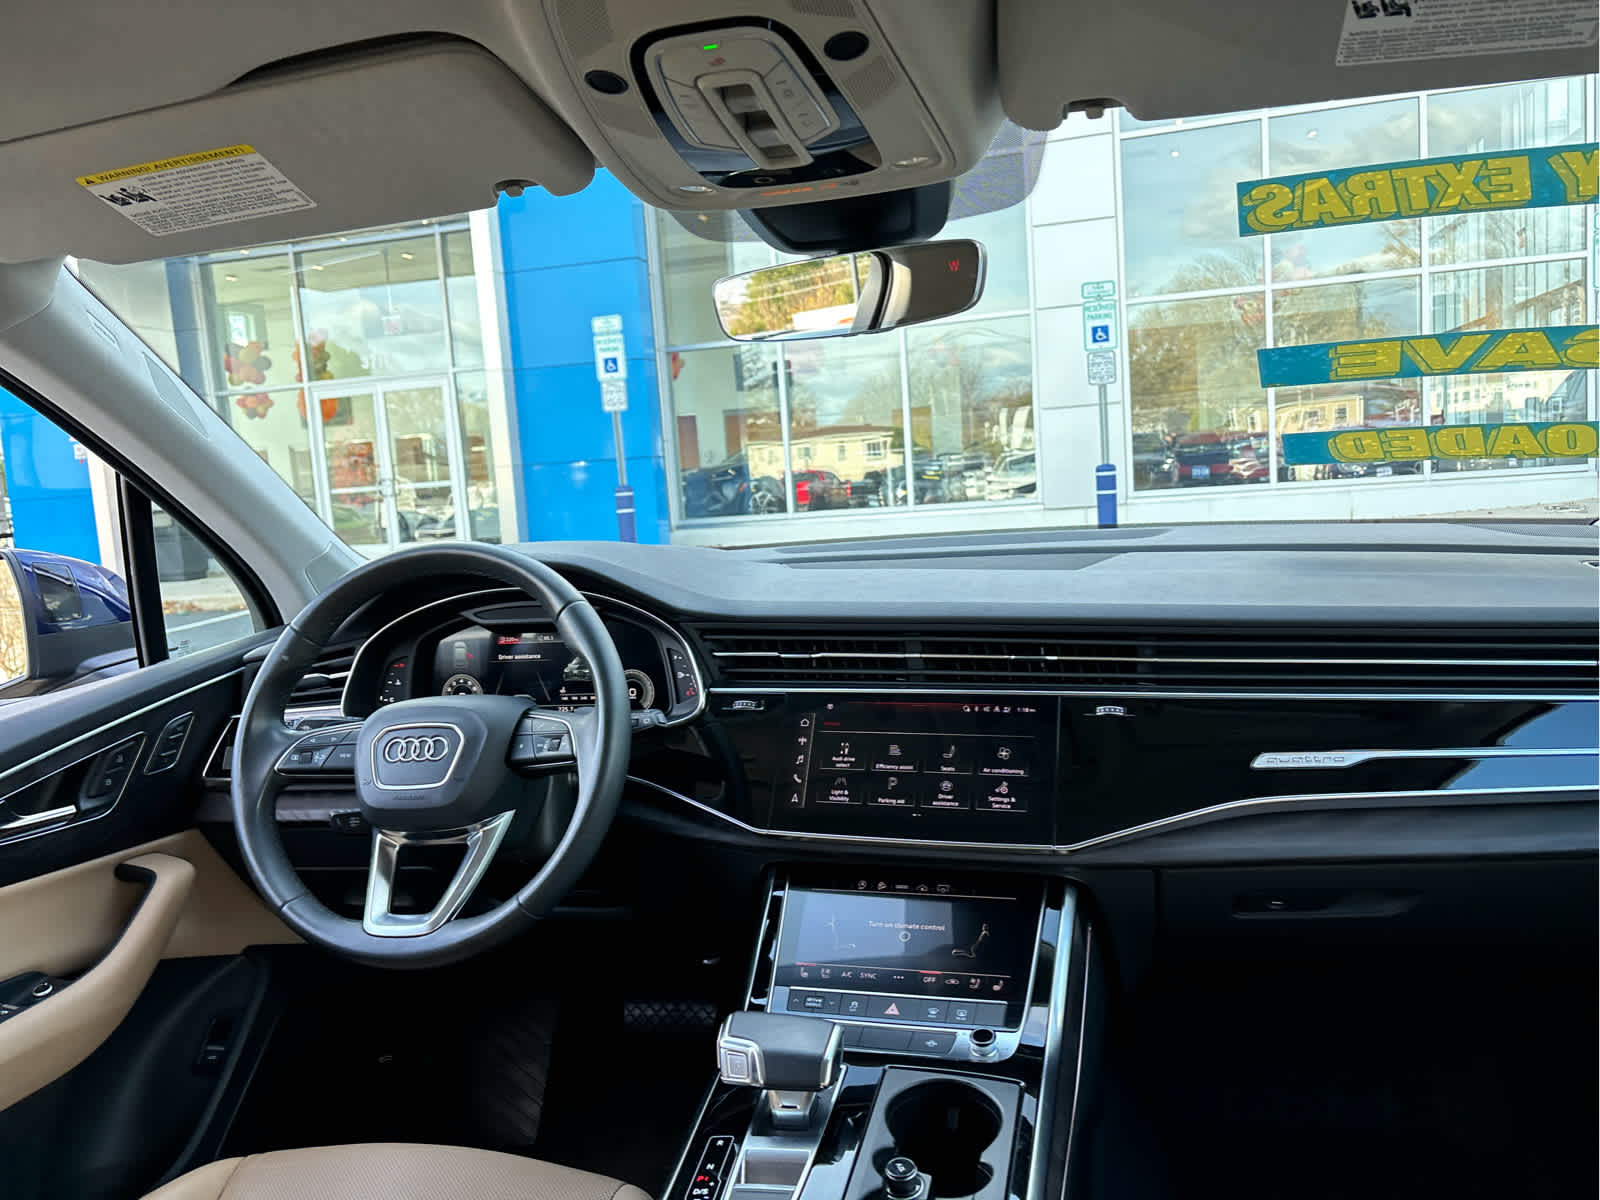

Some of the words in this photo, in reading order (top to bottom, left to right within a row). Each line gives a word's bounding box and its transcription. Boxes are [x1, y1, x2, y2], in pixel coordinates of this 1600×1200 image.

[154, 147, 245, 171] AVERTISSEMENT!
[948, 259, 960, 272] W
[1266, 756, 1344, 764] quattro
[878, 797, 896, 805] Parking
[988, 795, 1010, 803] Settings
[894, 922, 920, 930] climate
[858, 972, 878, 980] SYNC
